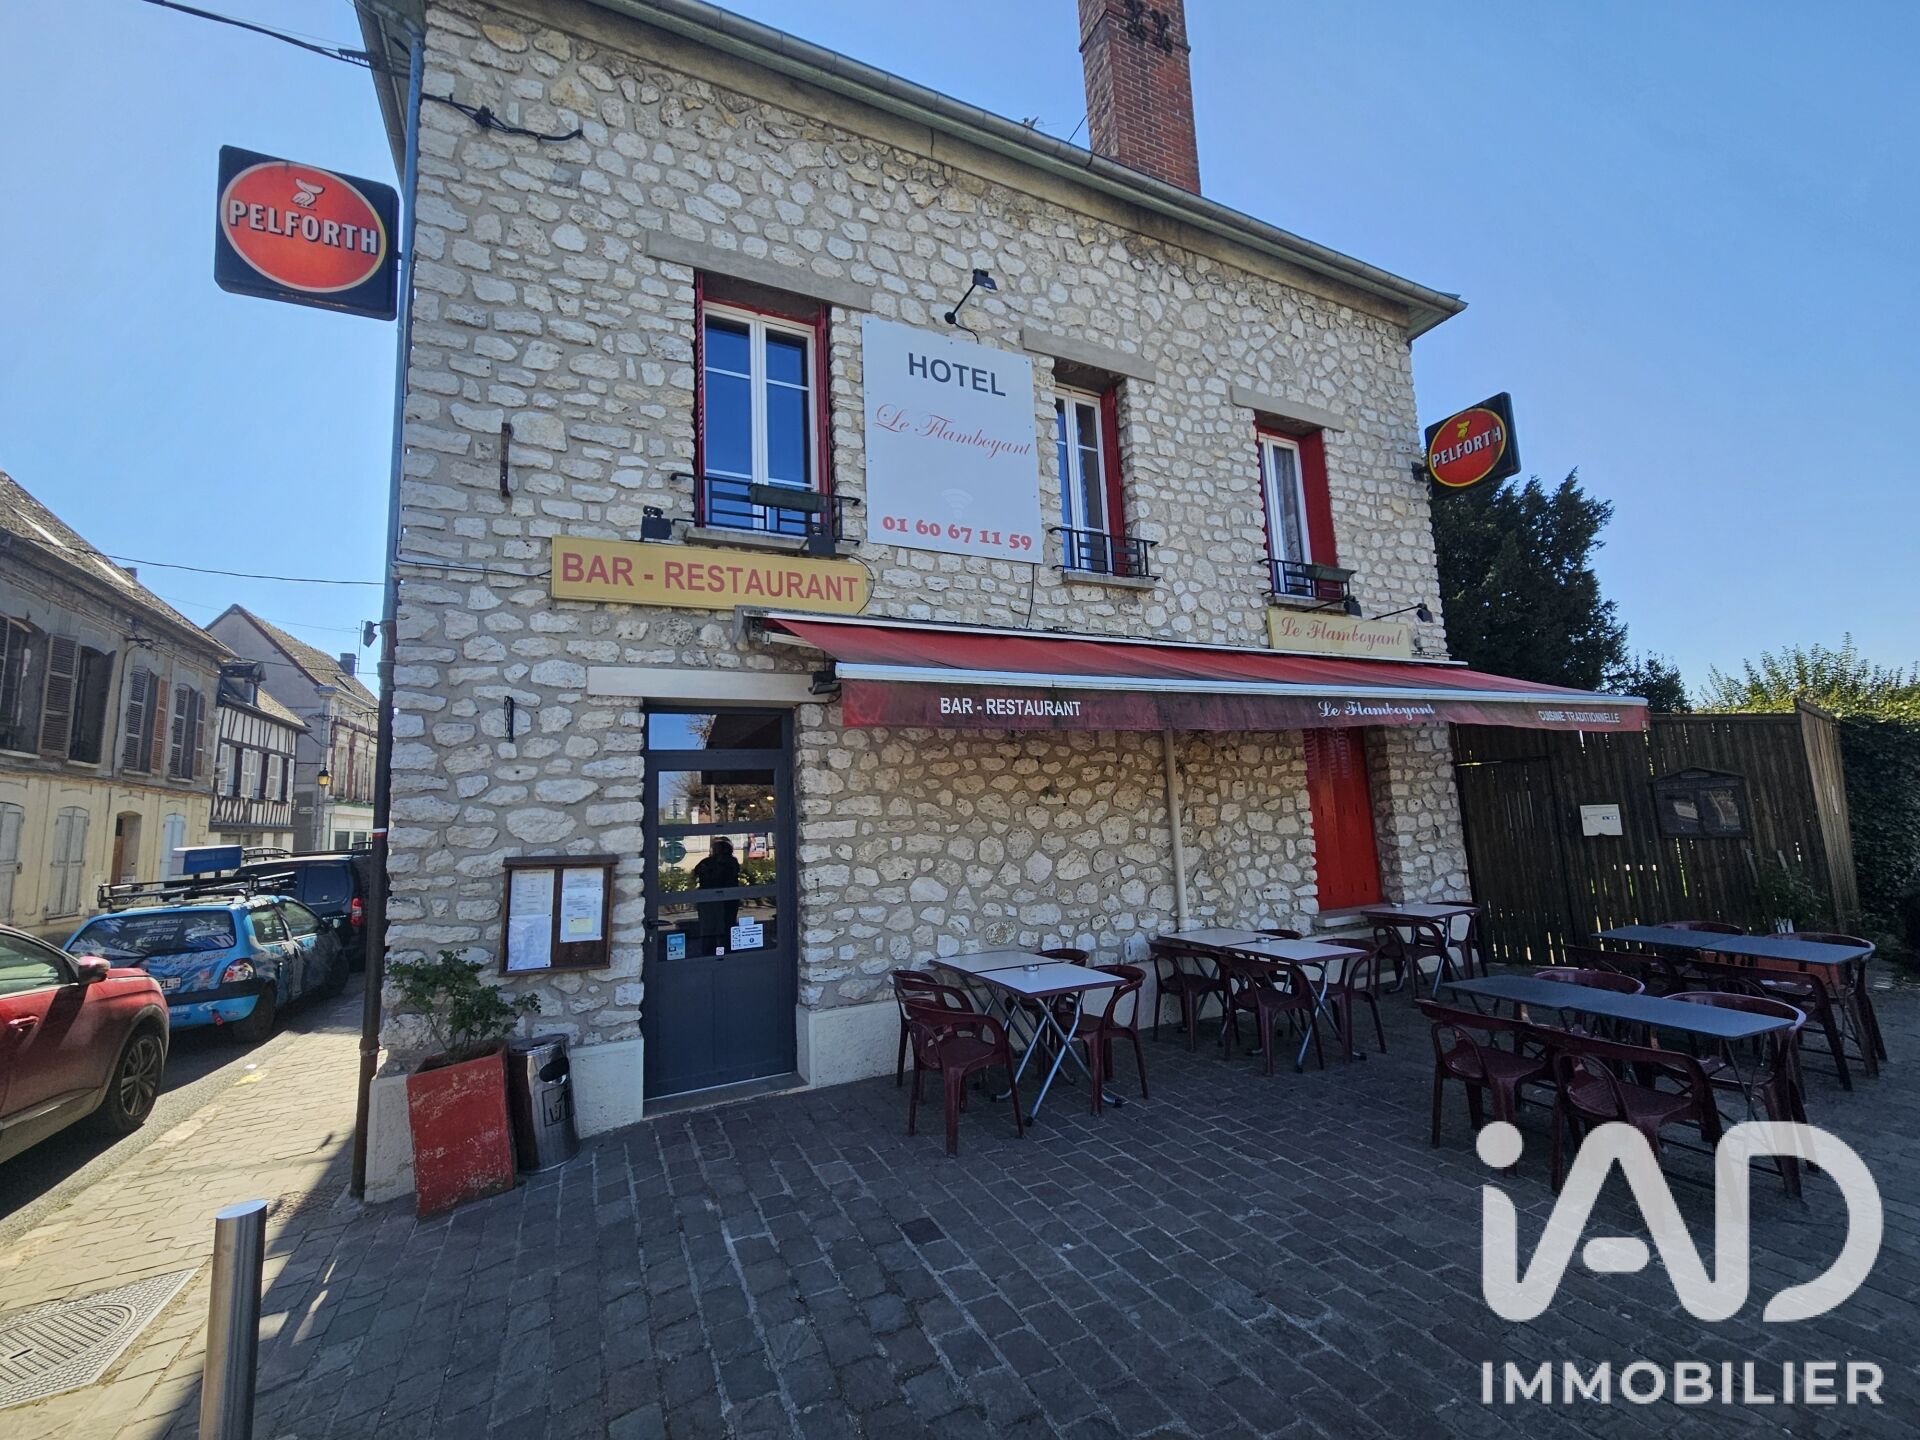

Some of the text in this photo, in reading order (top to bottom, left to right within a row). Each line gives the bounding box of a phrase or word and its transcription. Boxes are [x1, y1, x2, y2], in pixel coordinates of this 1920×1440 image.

[229, 199, 379, 255] PELFORTH
[908, 352, 1006, 397] HOTEL
[874, 403, 1031, 459] Le Flamboyant
[1432, 426, 1502, 468] PELFORTH
[882, 516, 1032, 550] 01 60 67 11 59
[562, 552, 635, 586] BAR
[664, 560, 859, 602] RESTAURANT
[1280, 616, 1403, 650] Le Flamboyant
[940, 697, 973, 714] BAR
[986, 698, 1081, 716] RESTAURANT
[1318, 701, 1436, 720] Le Flamboyant
[1538, 710, 1566, 721] CUISINE
